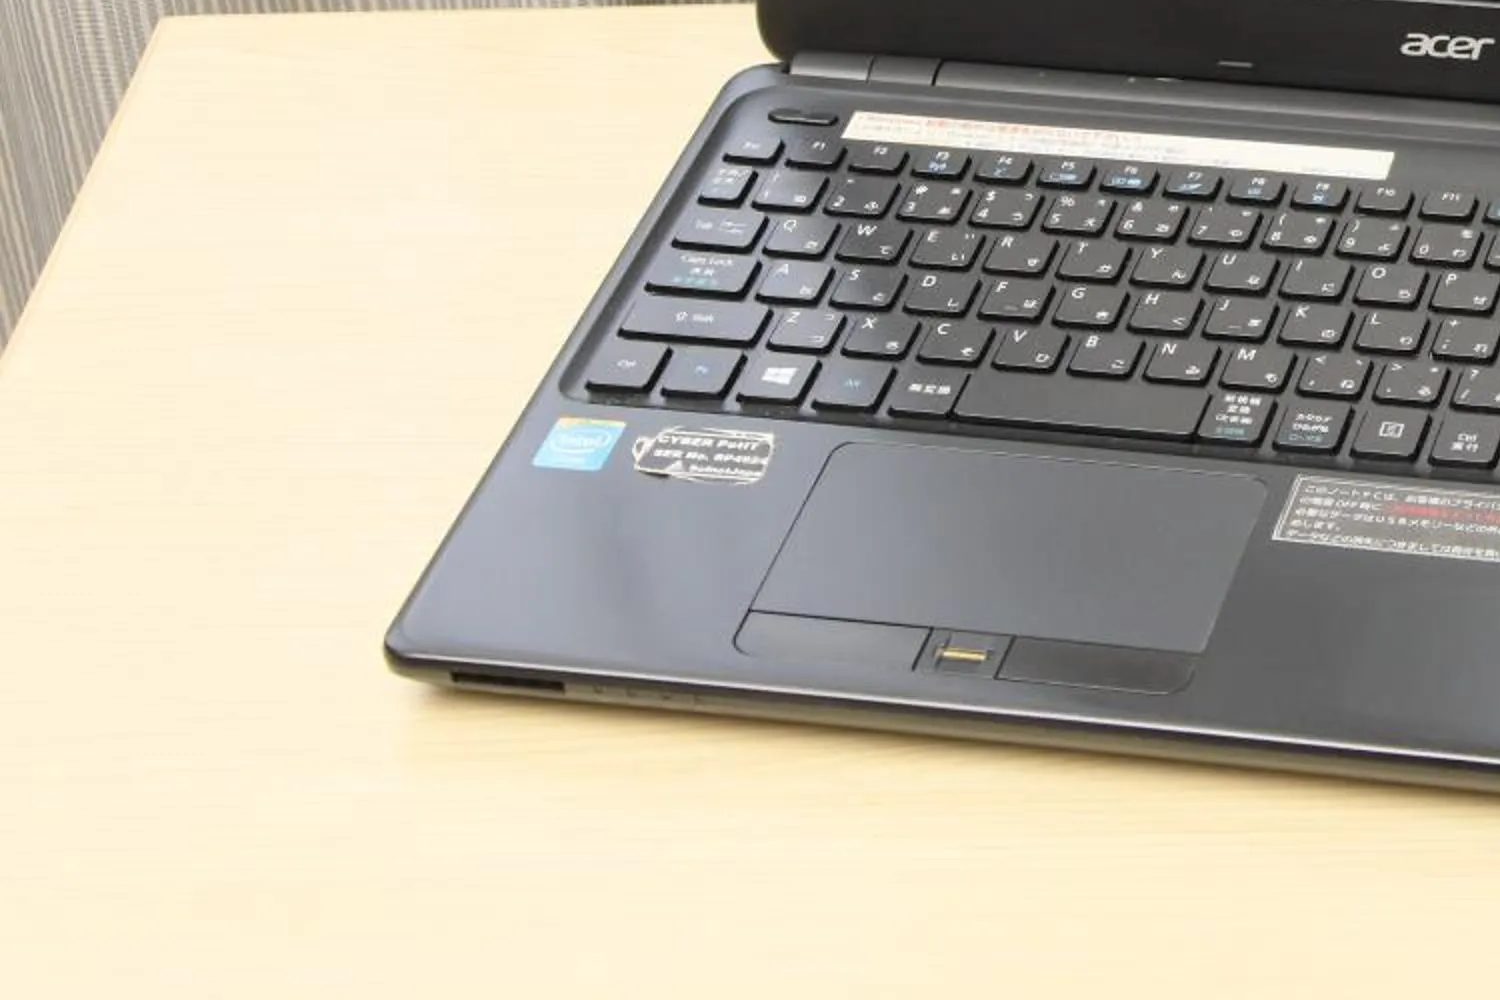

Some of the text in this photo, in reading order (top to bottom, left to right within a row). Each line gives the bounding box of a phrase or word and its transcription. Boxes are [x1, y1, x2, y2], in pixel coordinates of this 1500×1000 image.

[1400, 33, 1496, 60] acer
[906, 202, 916, 212] 3
[978, 208, 988, 218] 4
[1051, 214, 1061, 224] 5
[784, 220, 797, 232] Q
[858, 224, 877, 236] W
[1124, 220, 1134, 230] 6
[1198, 226, 1208, 234] 7
[928, 230, 938, 242] E
[1001, 236, 1014, 247] R
[1271, 232, 1281, 240] 8
[1079, 242, 1088, 253] T
[1346, 237, 1355, 248] 9
[1152, 248, 1163, 258] Y
[1223, 254, 1236, 264] U
[776, 264, 788, 274] A
[849, 269, 860, 280] S
[1372, 267, 1386, 278] O
[922, 276, 936, 286] D
[1446, 273, 1457, 285] P
[996, 282, 1008, 292] F
[1072, 287, 1086, 298] G
[1145, 294, 1160, 304] H
[1219, 299, 1229, 311] J
[1296, 306, 1309, 317] K
[787, 312, 800, 323] Z
[862, 318, 877, 328] X
[1370, 313, 1380, 324] L
[938, 324, 951, 334] C
[1014, 330, 1027, 342] V
[1086, 336, 1099, 347] B
[1162, 343, 1177, 354] N
[1238, 348, 1256, 360] M
[659, 436, 713, 447] CYBER
